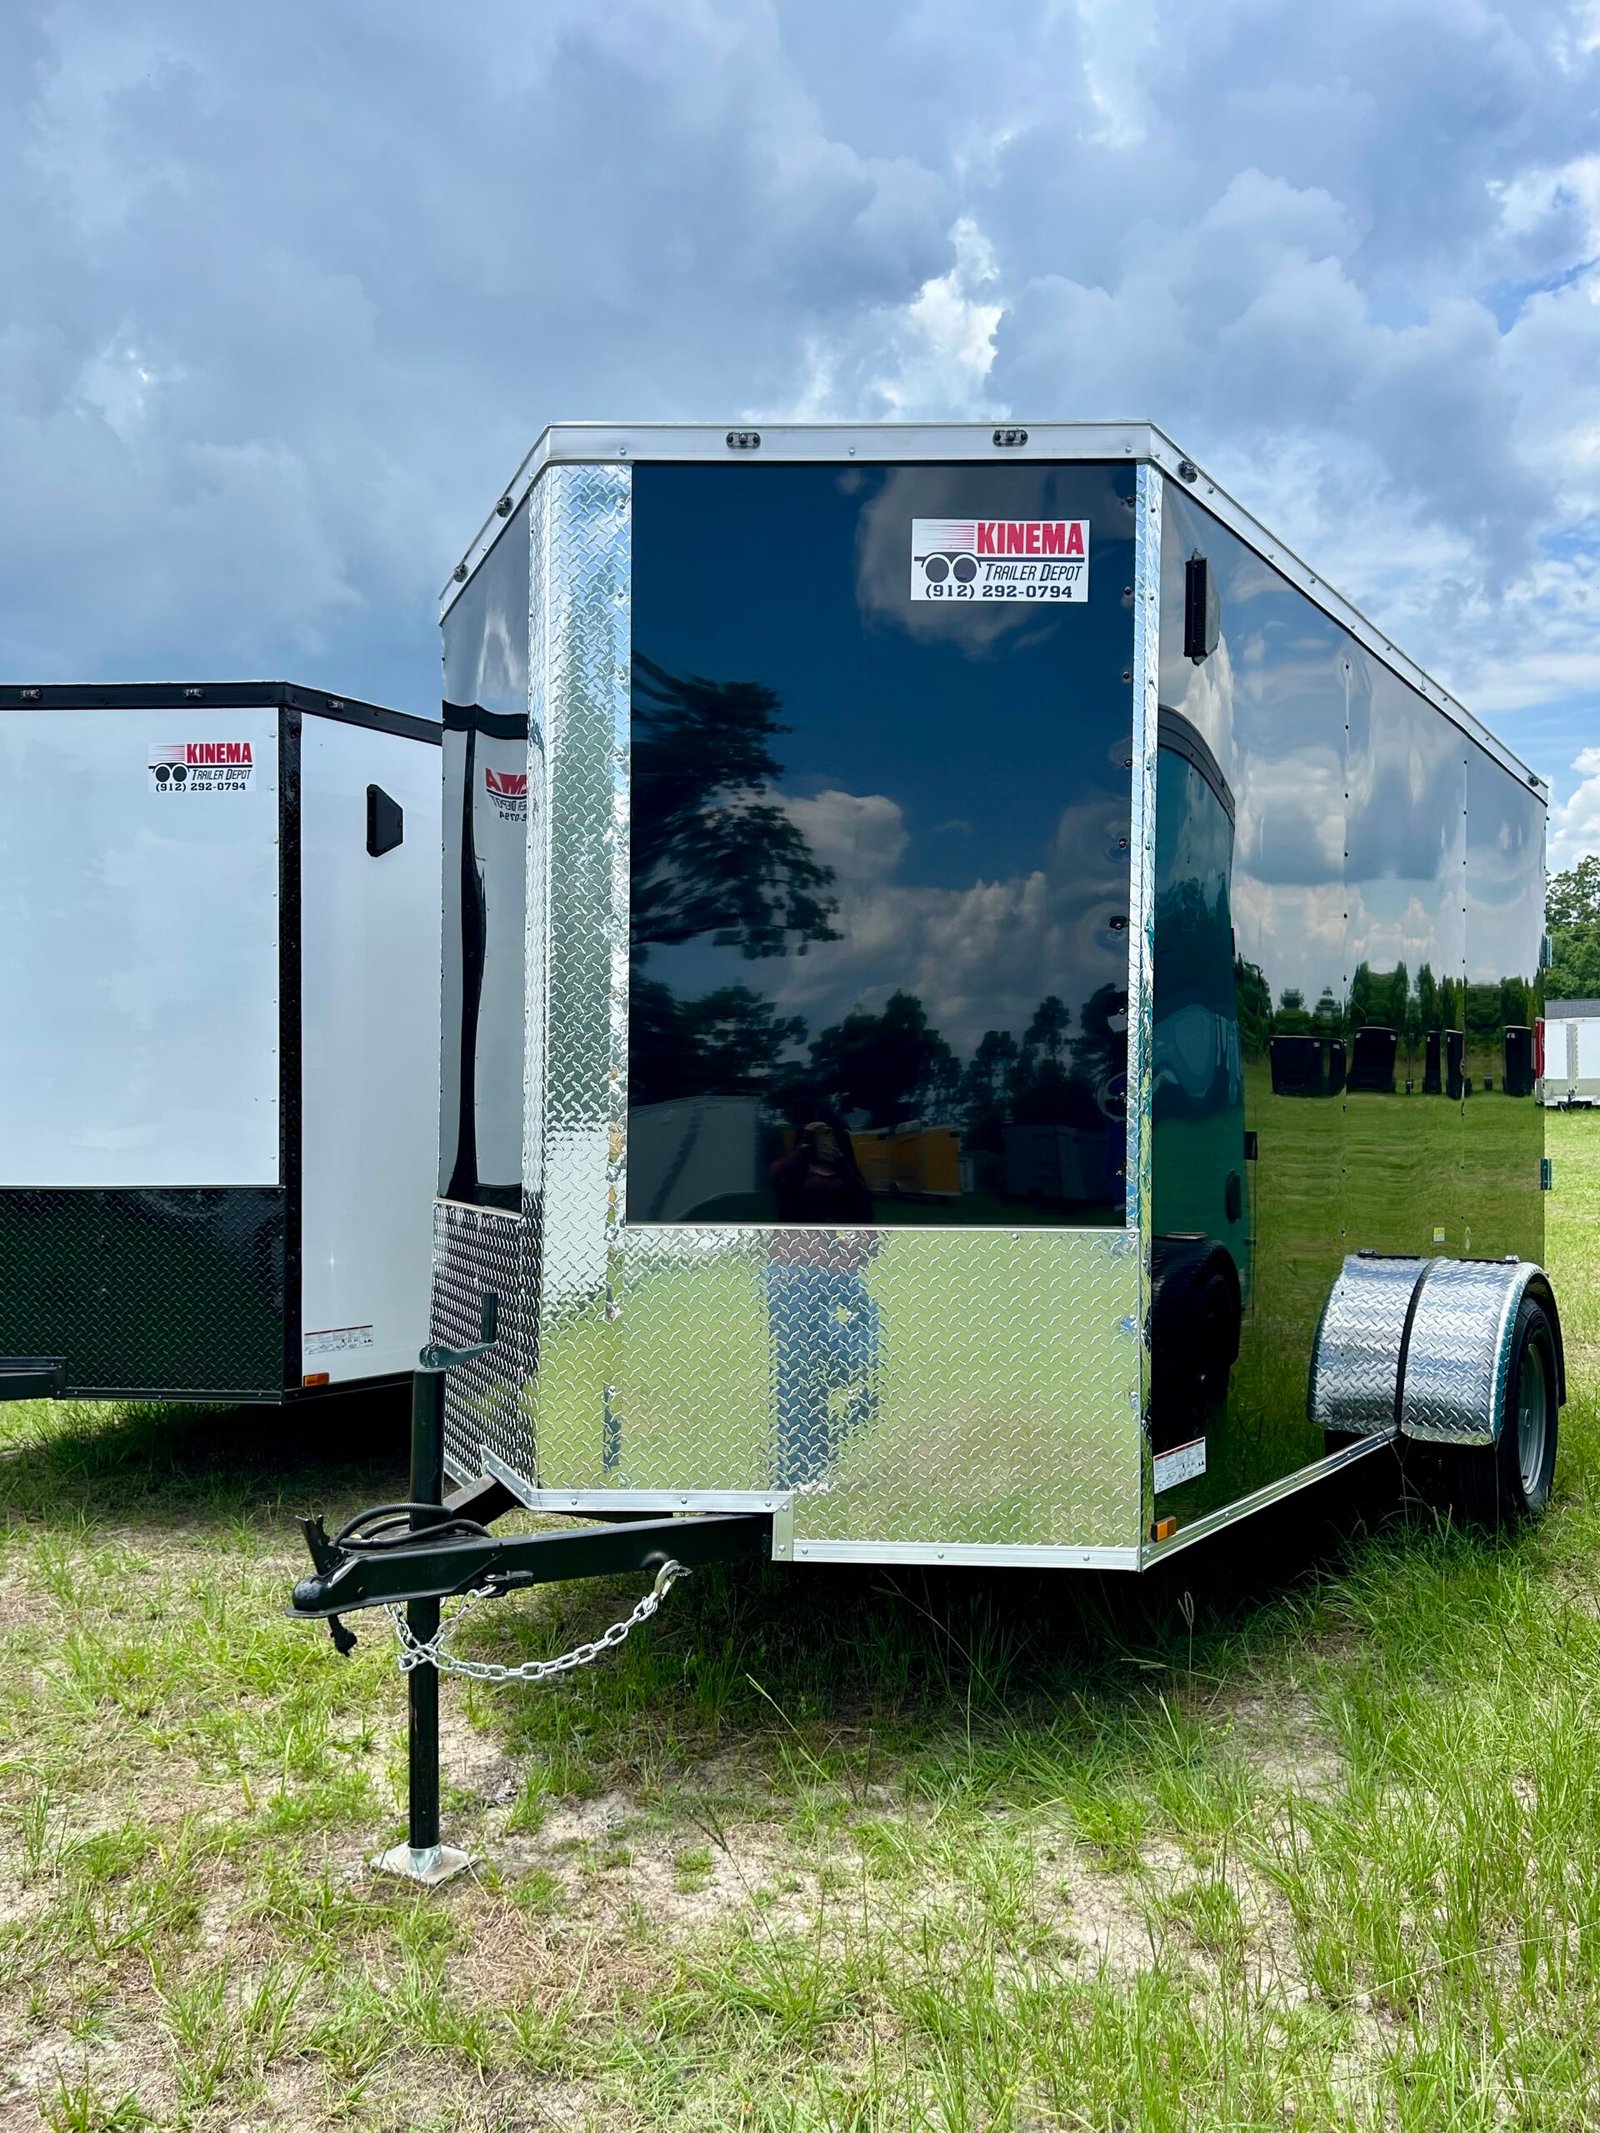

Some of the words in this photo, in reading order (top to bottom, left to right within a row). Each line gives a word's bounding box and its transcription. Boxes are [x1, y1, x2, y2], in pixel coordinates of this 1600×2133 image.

[977, 522, 1085, 555] KINEMA
[985, 563, 1038, 582] TRAILER
[1039, 563, 1083, 582] DEPOT
[926, 584, 975, 599] (912)
[982, 585, 1073, 598] 292-0794
[186, 742, 253, 764] KINEMA
[192, 769, 224, 781] TRAILER
[225, 768, 252, 781] DEPOT
[155, 782, 187, 793] (912)
[190, 782, 246, 791] 292-0794
